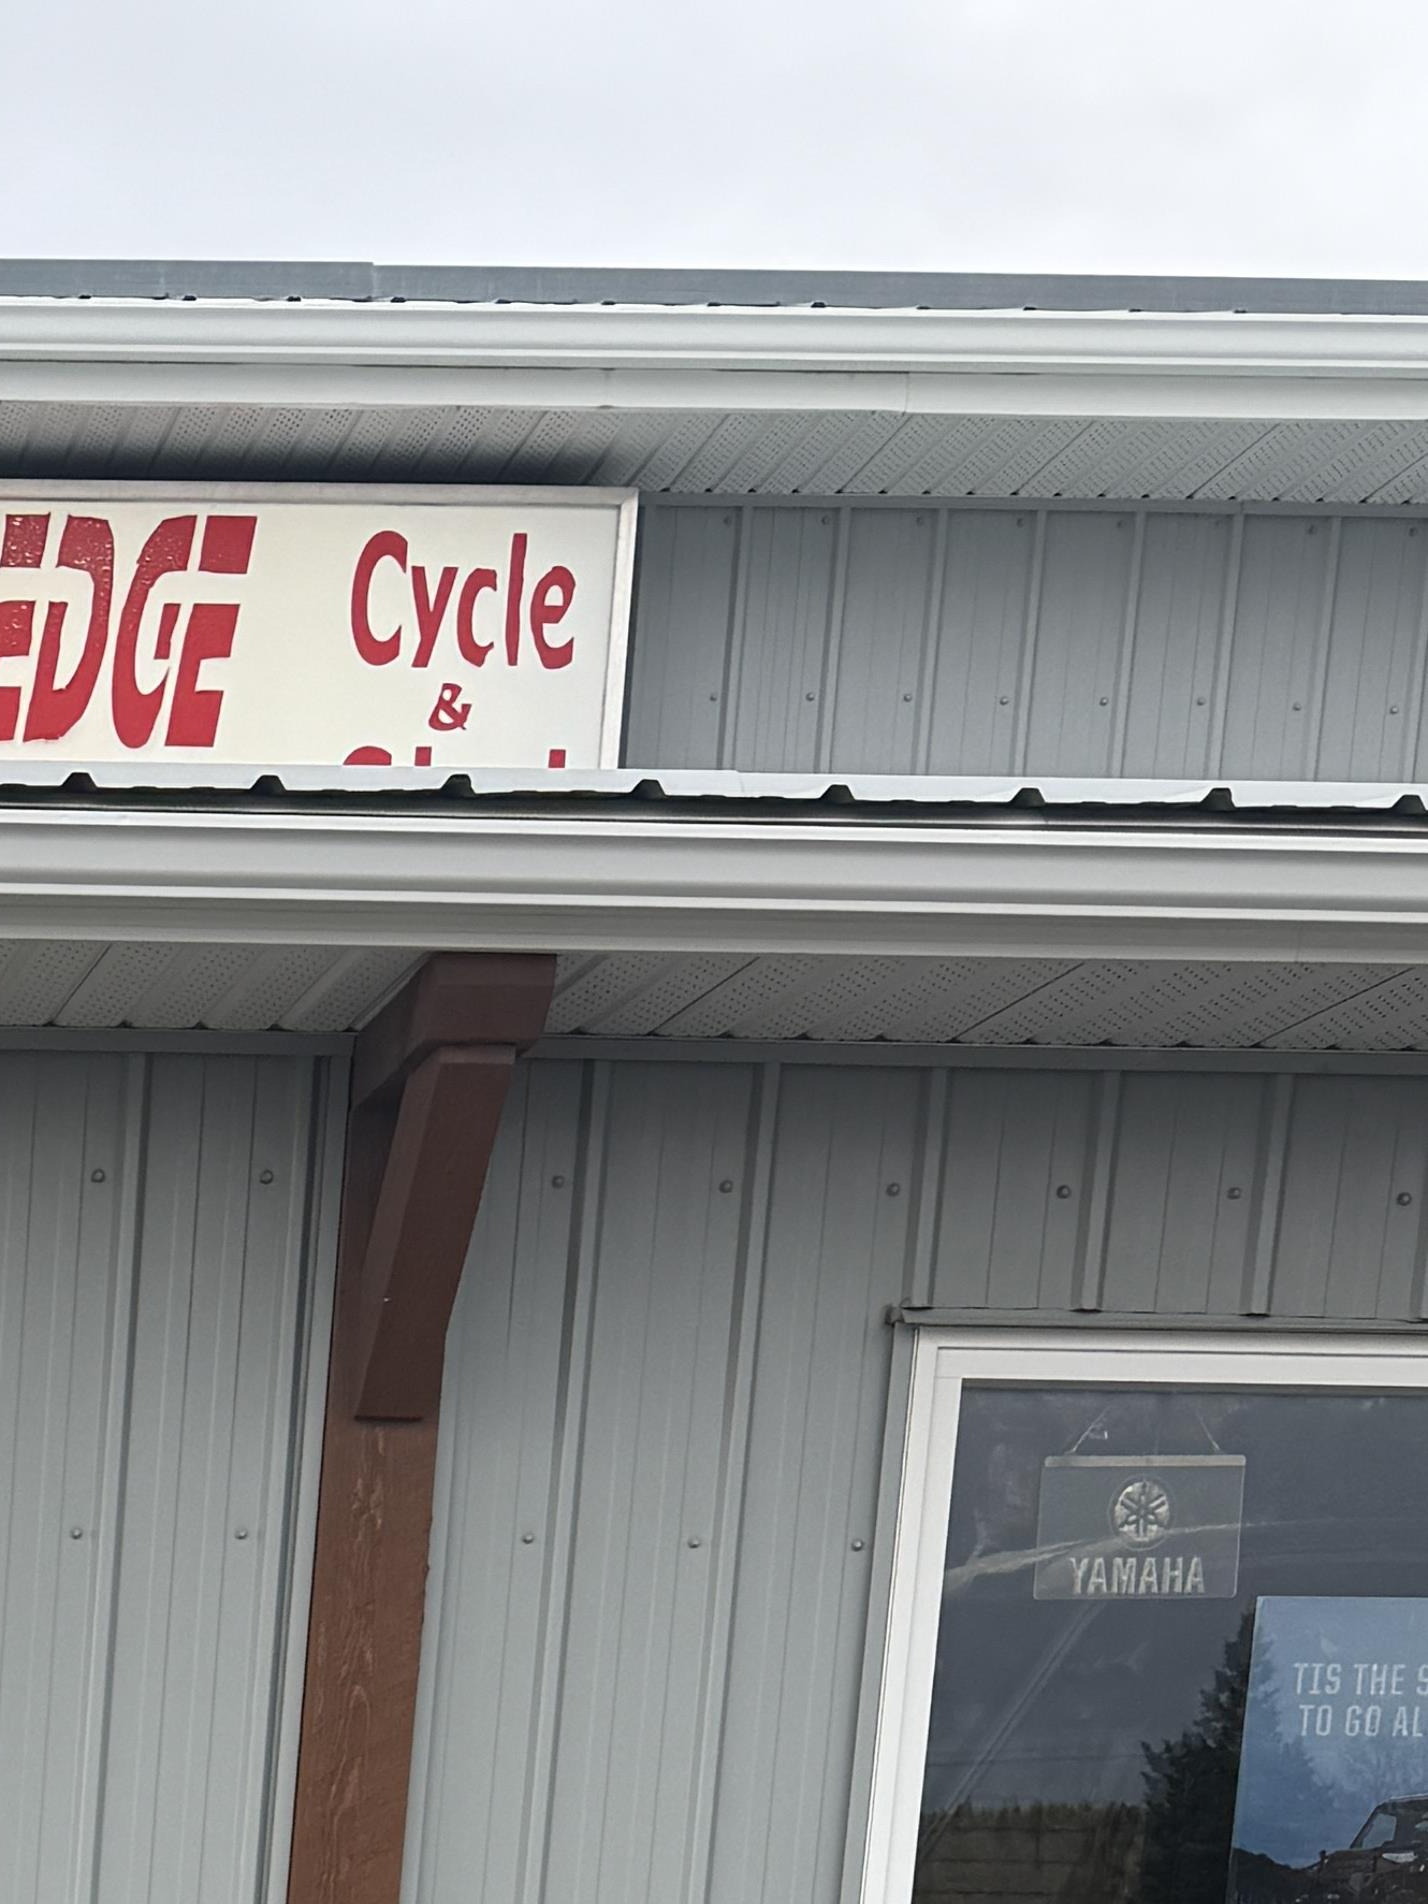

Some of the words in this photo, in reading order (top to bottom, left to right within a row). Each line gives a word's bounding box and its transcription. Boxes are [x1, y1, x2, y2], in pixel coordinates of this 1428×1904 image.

[351, 530, 576, 669] Cycle
[428, 682, 472, 730] &
[1069, 1557, 1205, 1594] YAMAHA
[1293, 1663, 1341, 1695] TIS
[1353, 1663, 1406, 1696] THE
[1299, 1705, 1332, 1736] TO
[1345, 1705, 1382, 1737] GO
